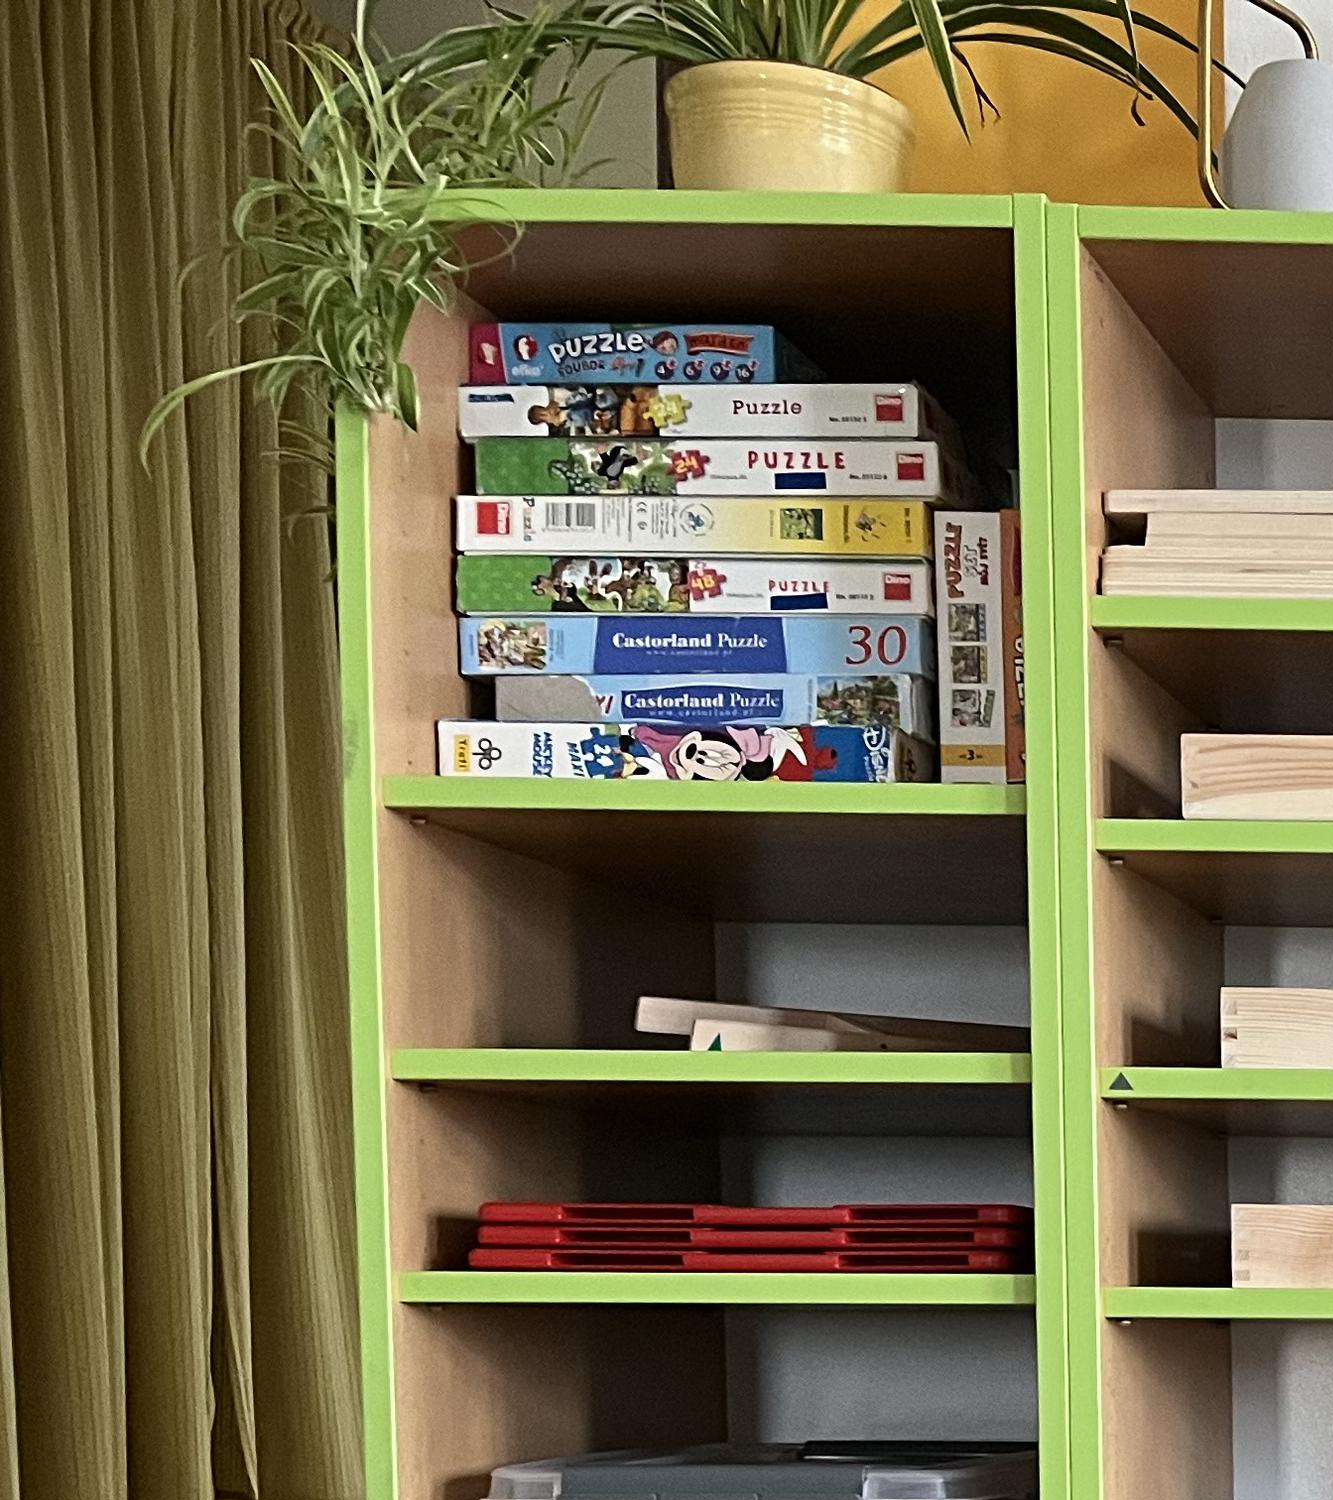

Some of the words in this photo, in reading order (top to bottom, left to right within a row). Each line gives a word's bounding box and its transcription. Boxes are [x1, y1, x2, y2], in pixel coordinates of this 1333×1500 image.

[732, 399, 802, 415] Puzzle
[674, 456, 700, 473] 24
[748, 451, 846, 470] PUZZLE
[522, 497, 535, 542] Puzzle
[944, 522, 964, 599] PUZZLE
[690, 574, 715, 590] 48
[768, 579, 830, 593] PUZZLE
[885, 574, 911, 585] Dino
[612, 632, 712, 649] Castorland
[717, 632, 768, 649] Puzzle
[845, 625, 908, 666] 30
[624, 692, 724, 708] Castorland
[729, 691, 780, 708] Puzzle
[566, 741, 585, 777] MAXI
[594, 743, 614, 767] 24
